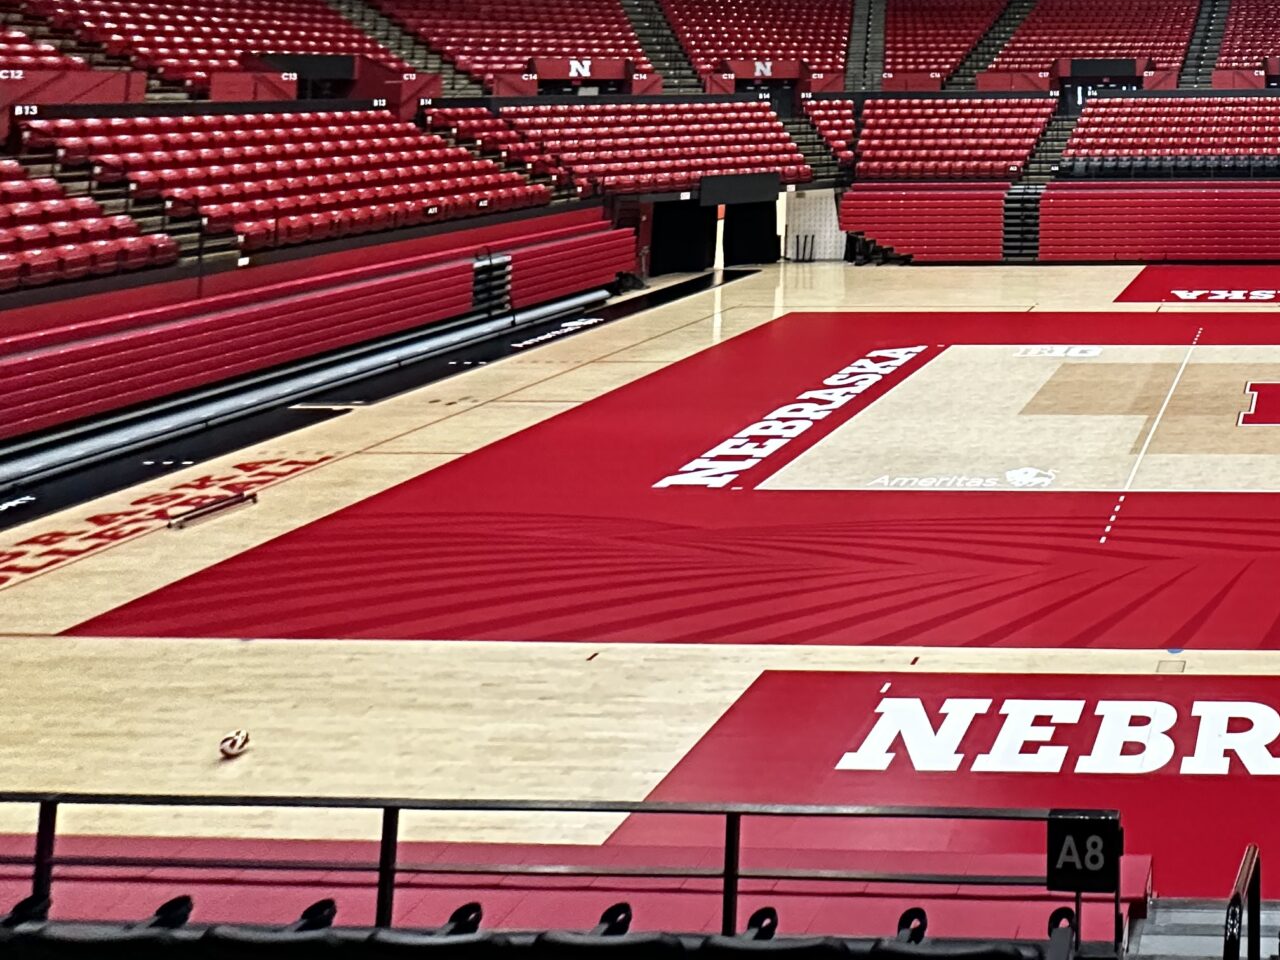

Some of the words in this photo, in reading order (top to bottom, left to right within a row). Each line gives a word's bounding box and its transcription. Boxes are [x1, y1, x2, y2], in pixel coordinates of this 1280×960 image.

[569, 60, 591, 77] N
[754, 61, 773, 76] N
[0, 69, 24, 80] C12
[281, 73, 298, 81] C13
[403, 73, 417, 81] C13
[521, 73, 538, 81] C14
[632, 73, 648, 81] C14
[373, 98, 387, 107] B13
[420, 98, 432, 106] B14
[14, 105, 38, 116] B13
[652, 344, 929, 489] NEBRASKA
[866, 474, 1000, 488] Ameritas
[1056, 835, 1104, 872] A8
